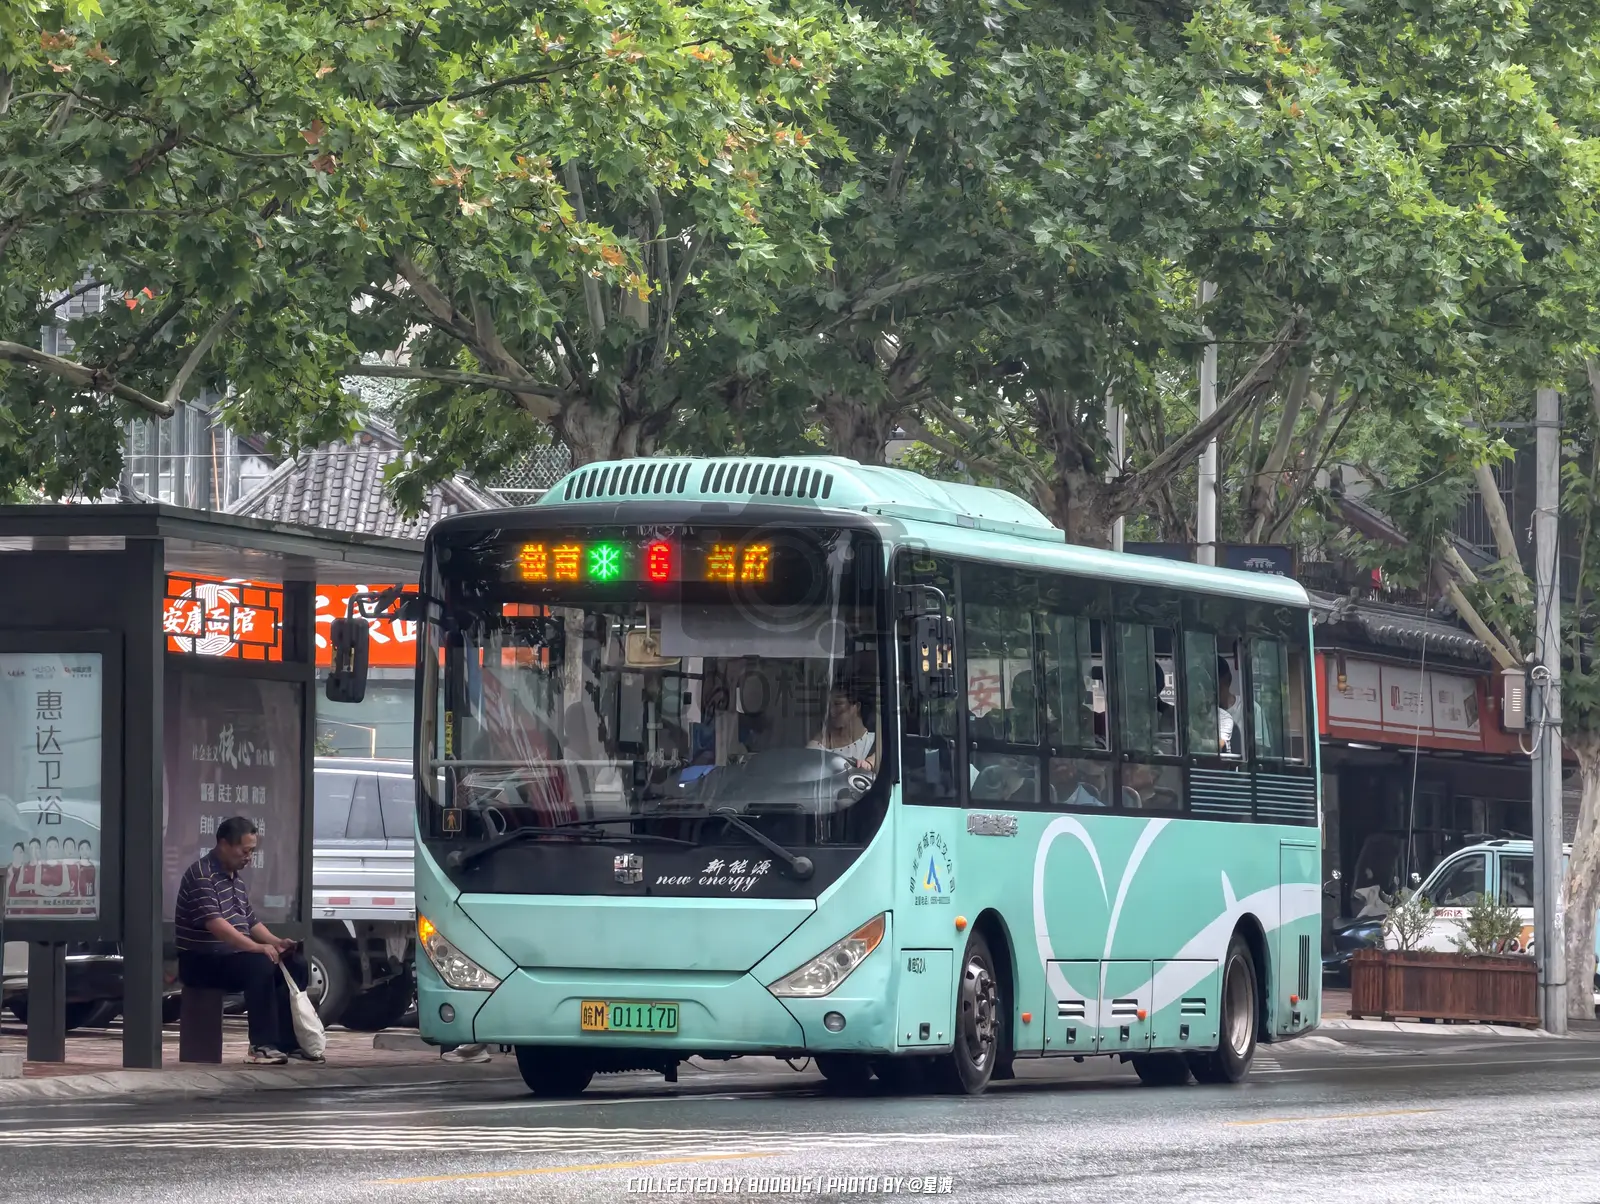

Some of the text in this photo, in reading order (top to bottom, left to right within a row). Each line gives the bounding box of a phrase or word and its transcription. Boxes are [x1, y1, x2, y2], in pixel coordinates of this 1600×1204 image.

[163, 605, 256, 634] 安康面馆
[36, 690, 63, 825] 惠达卫浴
[702, 858, 772, 876] 新能源
[656, 873, 760, 892] new energy
